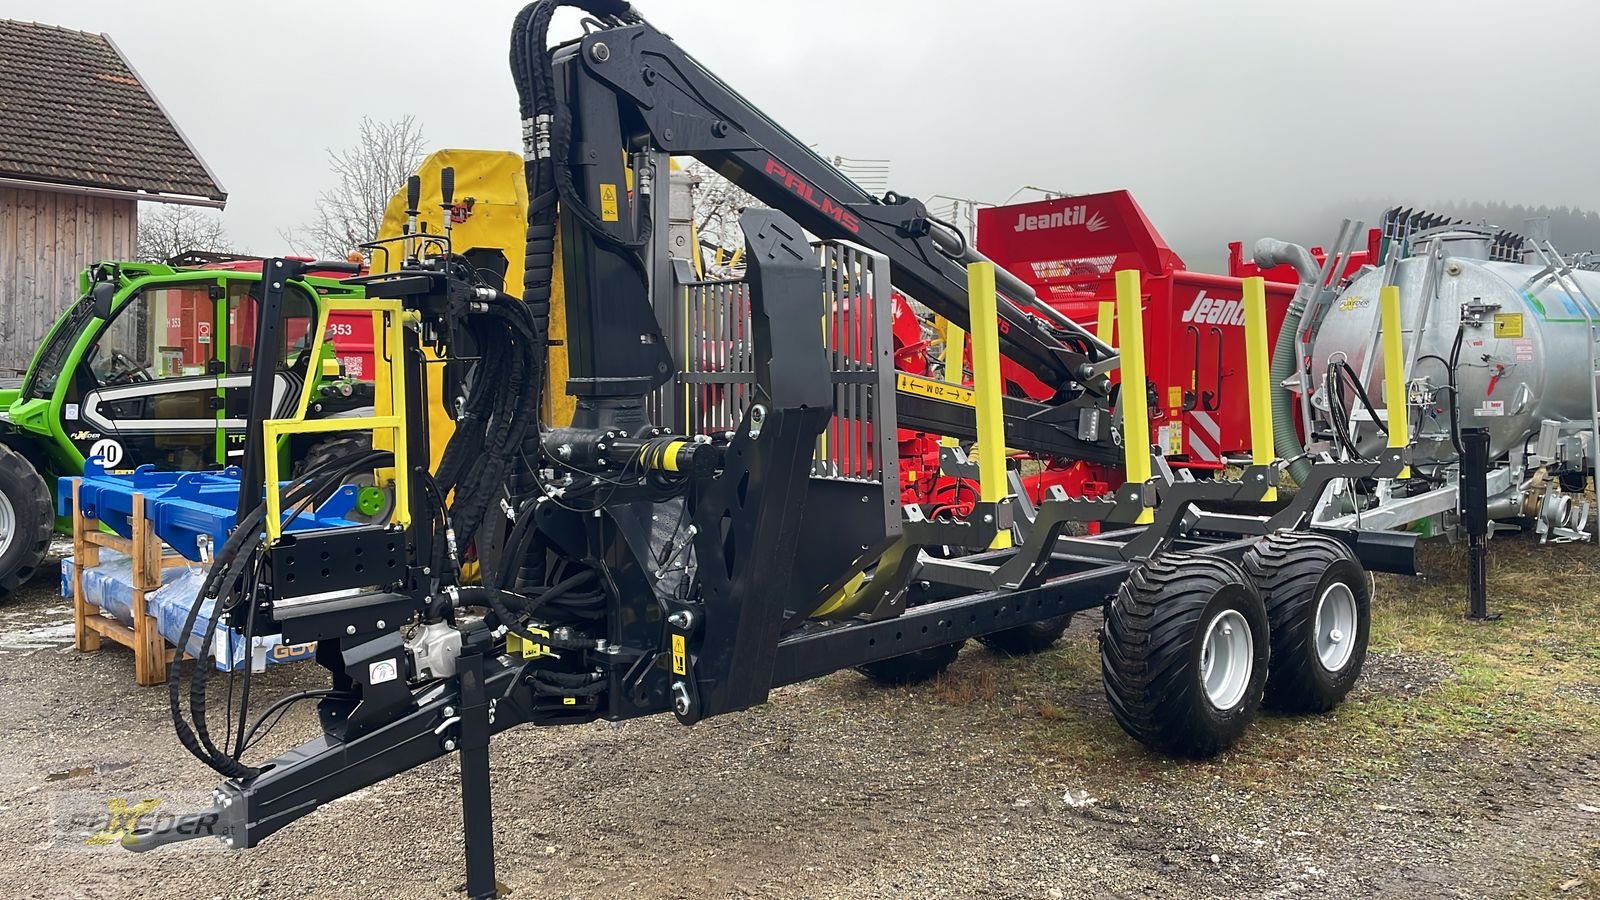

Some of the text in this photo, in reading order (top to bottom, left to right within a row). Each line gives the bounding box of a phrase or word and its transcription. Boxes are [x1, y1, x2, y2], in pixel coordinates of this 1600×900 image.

[765, 159, 859, 233] PALMS
[1013, 205, 1087, 232] Jeantil
[330, 323, 352, 335] 353
[97, 444, 116, 463] 40
